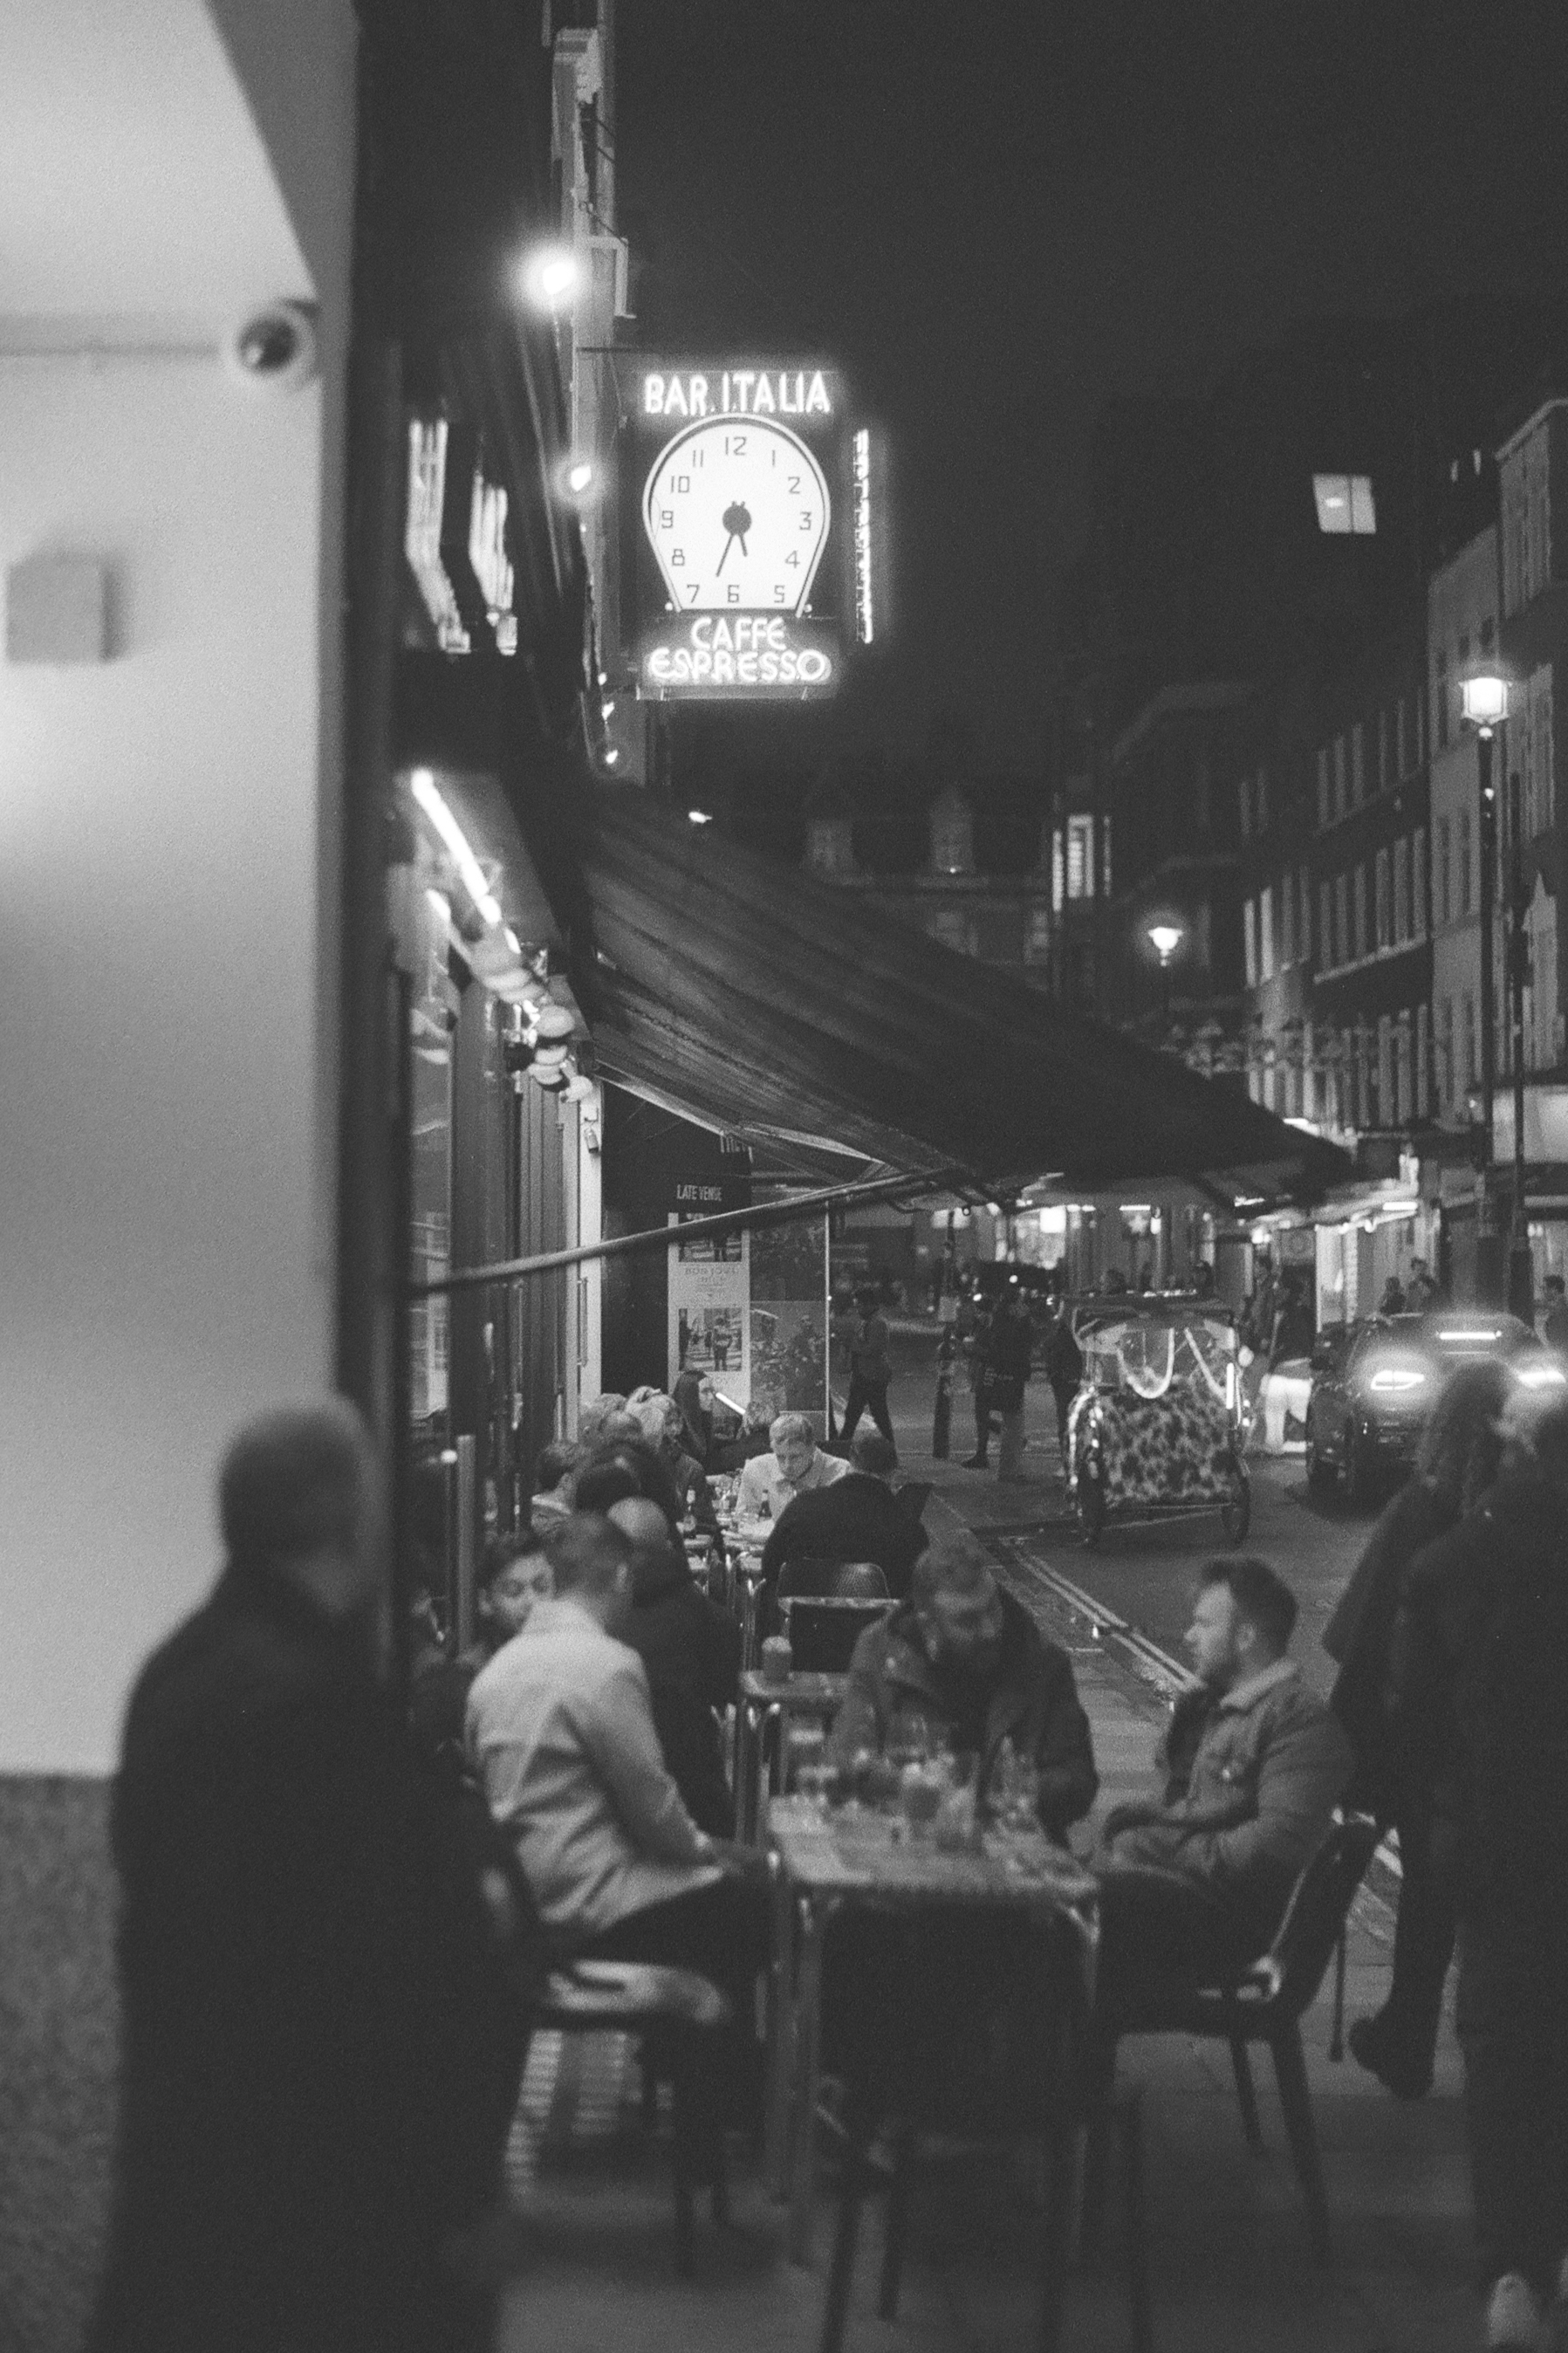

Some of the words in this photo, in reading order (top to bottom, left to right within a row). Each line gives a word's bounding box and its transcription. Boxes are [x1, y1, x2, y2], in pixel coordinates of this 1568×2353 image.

[645, 374, 707, 415] BAR
[722, 370, 831, 414] ITALIA
[724, 436, 747, 456] 12
[692, 449, 704, 468] 11
[771, 449, 777, 468] 1
[670, 475, 690, 494] 10
[787, 476, 801, 494] 2
[661, 510, 674, 529] 9
[799, 511, 812, 531] 3
[671, 548, 685, 566] 8
[784, 550, 801, 569] 4
[686, 584, 700, 603] 7
[727, 584, 740, 604] 6
[773, 584, 785, 604] 5
[690, 616, 787, 650] CAFFE
[649, 647, 828, 682] ESPRESSO
